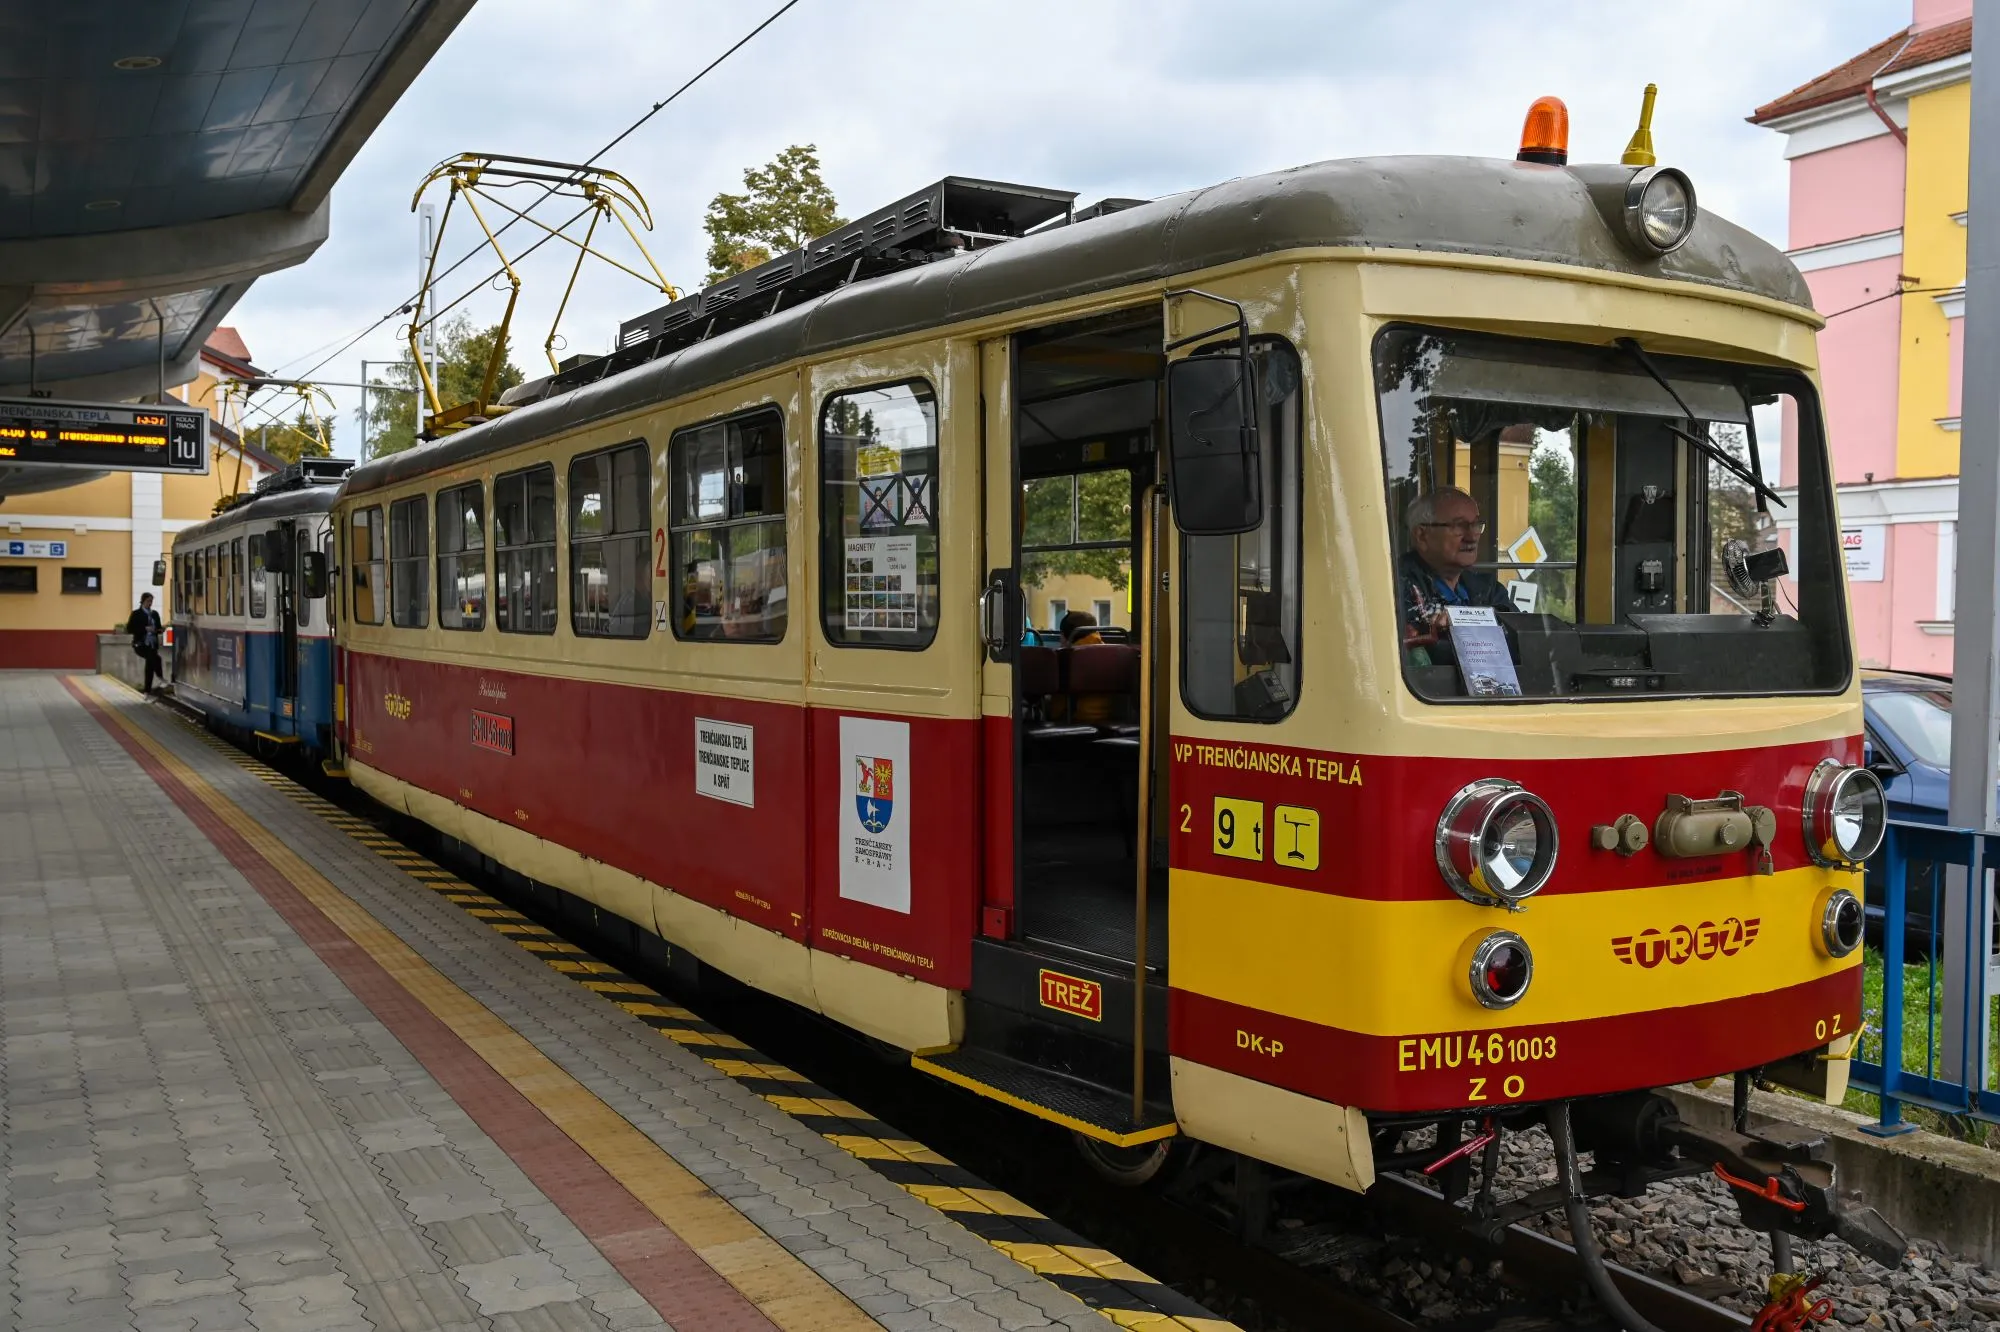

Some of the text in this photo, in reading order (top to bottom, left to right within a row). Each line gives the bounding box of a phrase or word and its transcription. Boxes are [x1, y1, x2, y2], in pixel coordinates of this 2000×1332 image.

[0, 405, 73, 418] RENČIANSKA
[173, 435, 196, 459] 1u
[655, 528, 666, 577] 2
[700, 729, 747, 751] TRENČIANSKA TEPLÁ
[698, 749, 750, 773] TRENČIANSKE TEPLICE
[1174, 743, 1363, 786] VP TRENČIANSKA TEPLÁ
[713, 773, 717, 787] A
[1180, 803, 1192, 833] 2
[1217, 808, 1261, 855] 9 t
[855, 837, 892, 852] TRENČIANSKY
[872, 942, 880, 953] VP
[880, 945, 916, 965] TRENČIANSKA
[916, 955, 935, 970] TEPLÁ
[1635, 917, 1744, 969] TREŽ
[1044, 978, 1093, 1012] TREŽ
[1832, 1013, 1841, 1035] Z
[1236, 1029, 1284, 1059] DK-P
[1468, 1075, 1525, 1101] Z O
